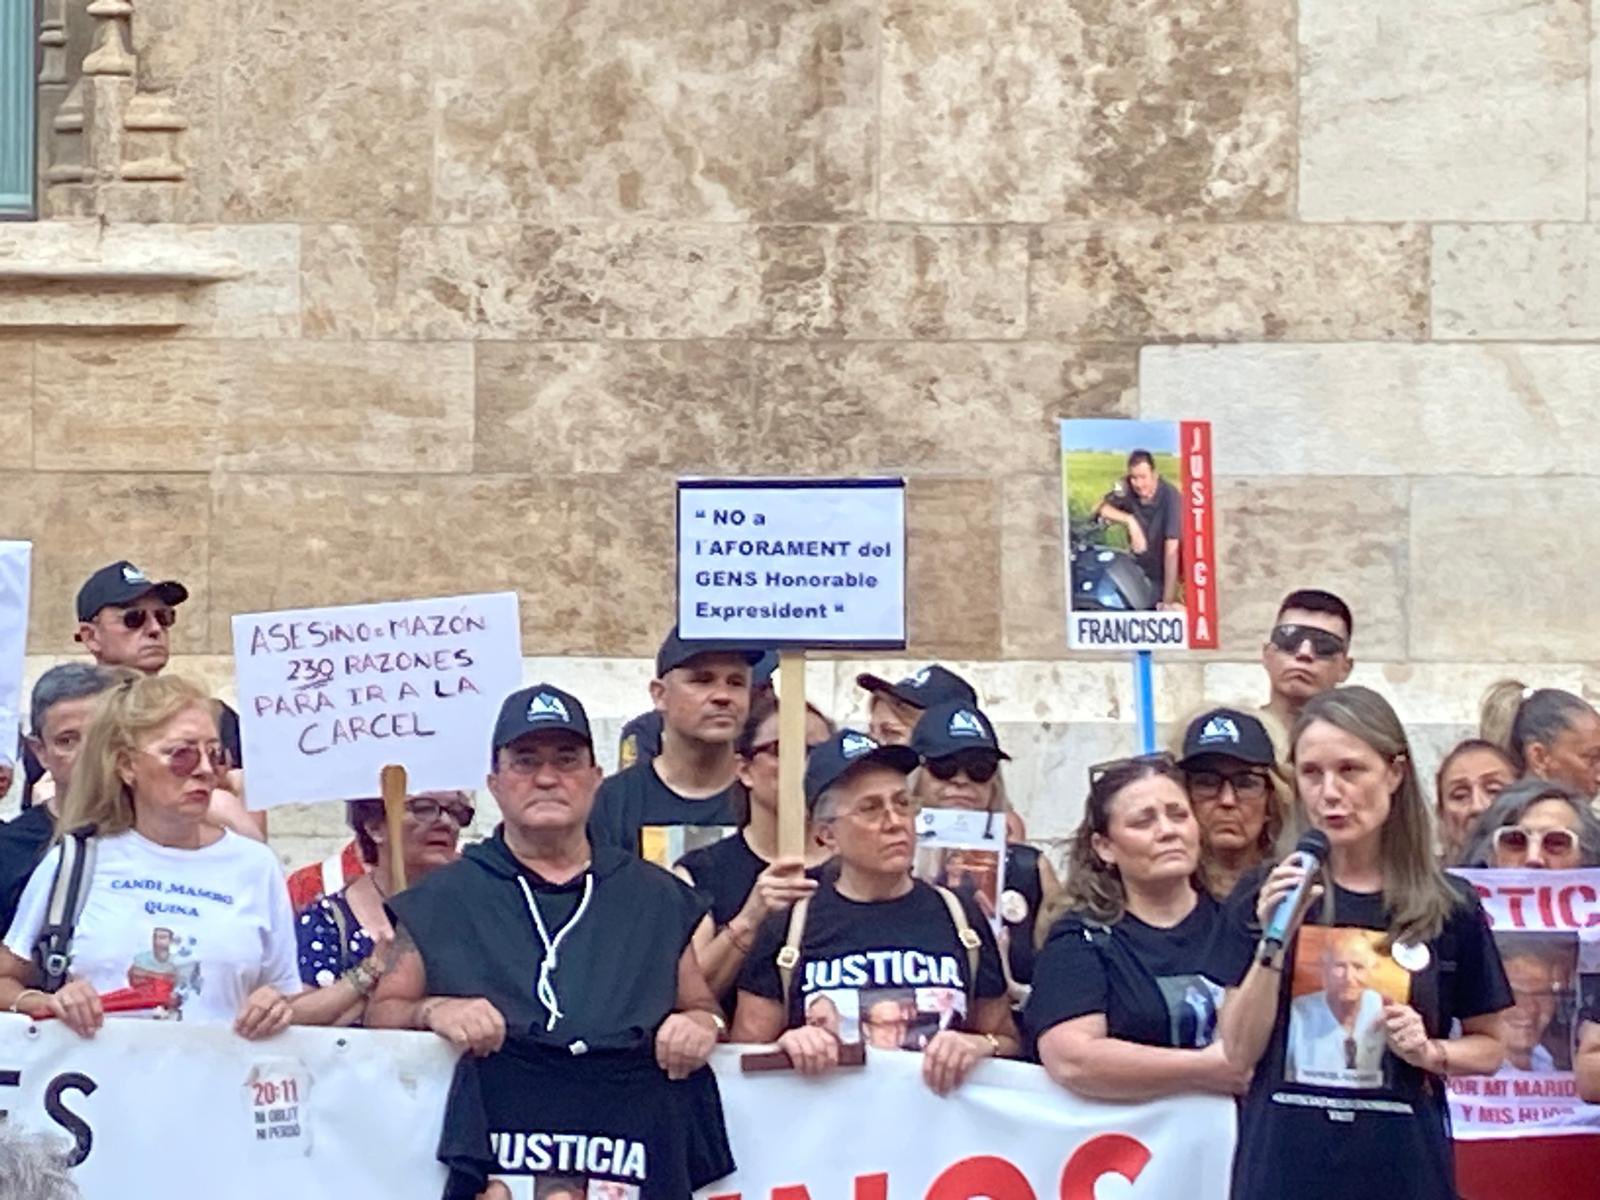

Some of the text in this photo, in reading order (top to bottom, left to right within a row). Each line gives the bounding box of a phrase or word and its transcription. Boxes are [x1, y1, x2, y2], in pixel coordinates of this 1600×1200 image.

[713, 509, 746, 526] NO
[752, 513, 766, 526] a
[1190, 427, 1210, 641] JUSTICIA
[858, 542, 891, 558] del
[695, 571, 879, 588] GENS Honorable
[695, 602, 828, 622] Expresident
[1077, 617, 1184, 644] FRANCISCO
[287, 648, 474, 682] 230 RAZONES
[254, 676, 481, 718] PARA IR A LA
[297, 711, 436, 756] CARCEL
[111, 879, 163, 892] CANDI
[145, 900, 199, 917] QUINA
[802, 950, 964, 992] JUSTICIA
[253, 1079, 299, 1106] 20:11
[1462, 1104, 1473, 1122] Y
[1479, 1106, 1515, 1124] MIS
